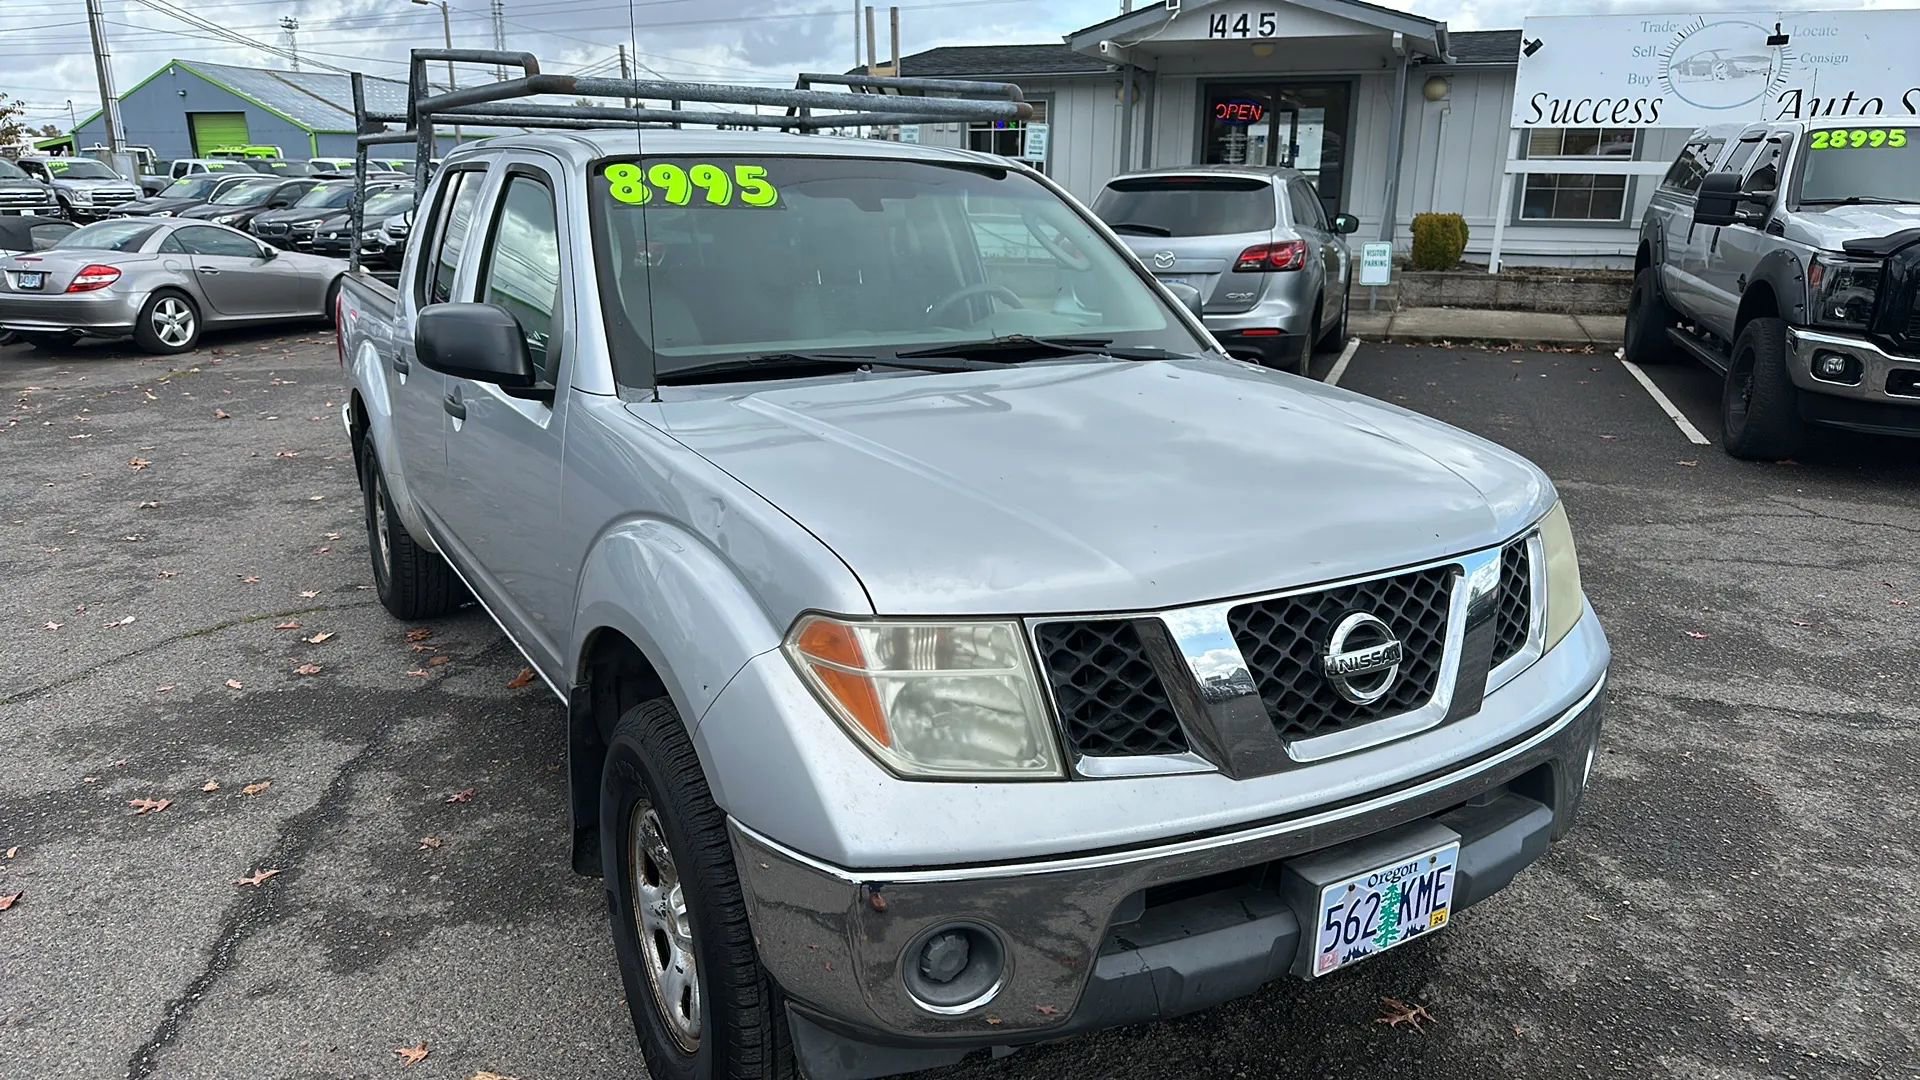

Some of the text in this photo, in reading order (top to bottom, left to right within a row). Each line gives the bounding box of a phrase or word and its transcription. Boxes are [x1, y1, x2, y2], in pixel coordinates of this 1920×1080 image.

[1209, 12, 1276, 38] 1445
[1641, 21, 1678, 33] Trade
[1793, 25, 1838, 37] Locate
[1632, 46, 1656, 58] Sell
[1801, 52, 1849, 66] Consign
[1628, 73, 1653, 87] Buy
[1215, 103, 1263, 121] OPEN
[1523, 92, 1663, 125] Success
[1776, 89, 1883, 120] Auto
[1810, 129, 1908, 149] 28995
[604, 163, 778, 207] 8995
[1366, 249, 1387, 257] VISITOR
[1338, 643, 1400, 674] NISSAN
[1367, 861, 1419, 889] Oregon
[1323, 864, 1452, 954] 562 KME
